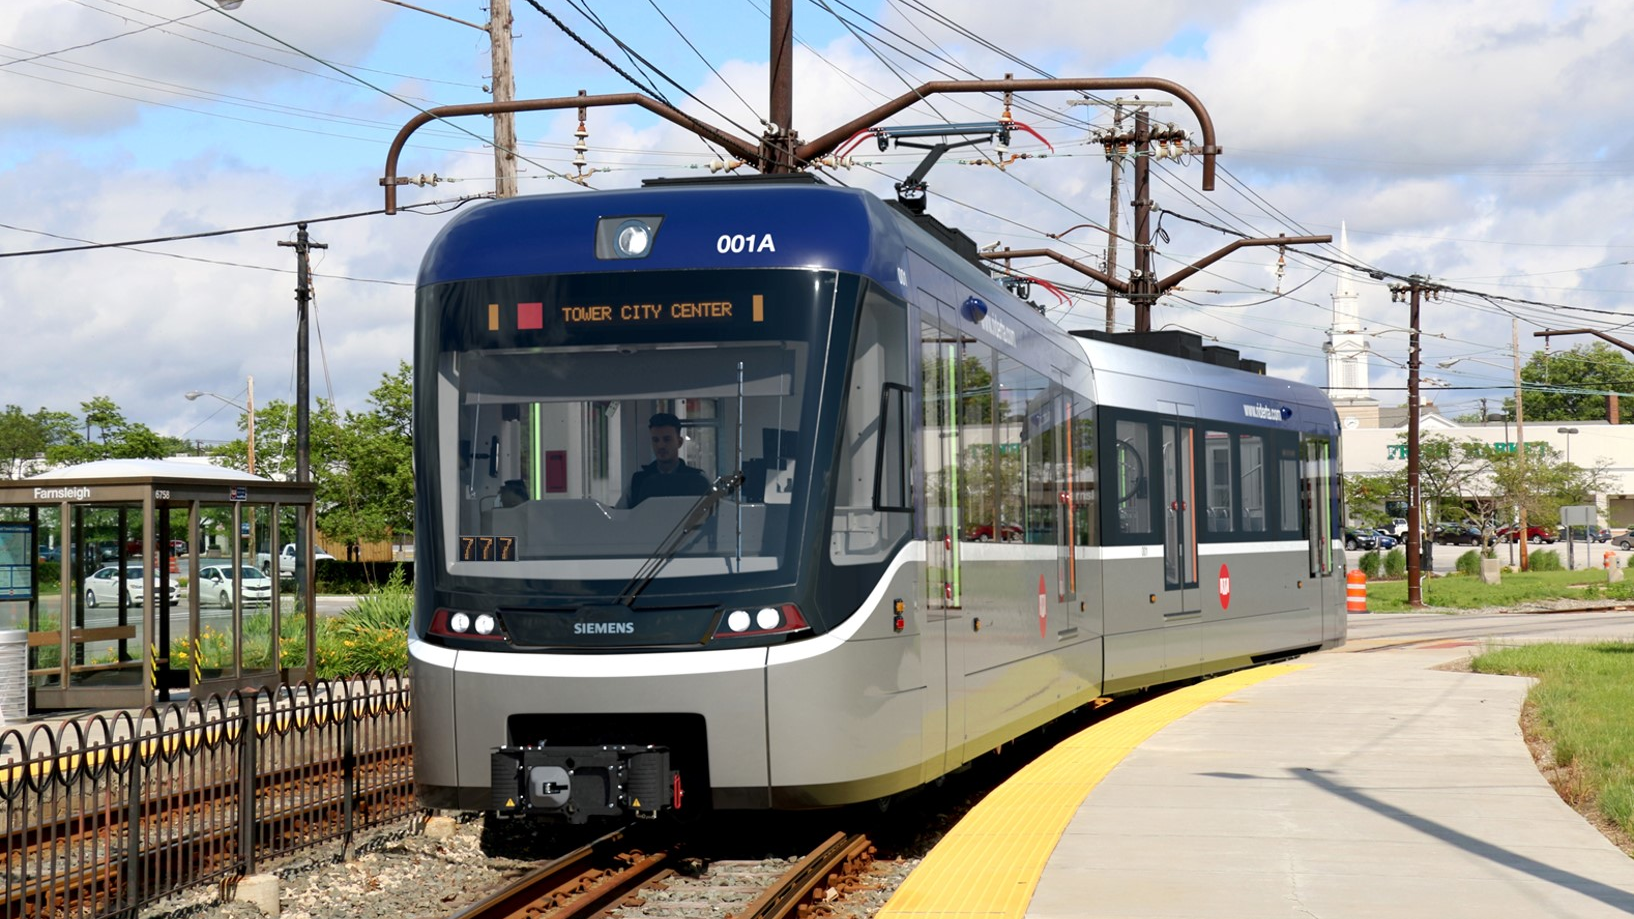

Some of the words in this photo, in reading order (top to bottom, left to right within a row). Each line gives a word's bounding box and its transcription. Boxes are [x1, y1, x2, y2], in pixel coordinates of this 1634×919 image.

[716, 234, 776, 254] 001A
[562, 306, 612, 322] TOWER
[621, 304, 662, 320] CITY
[671, 302, 732, 318] CENTER
[34, 486, 91, 500] Farnsleigh
[155, 489, 170, 499] 6758
[573, 622, 635, 634] SIEMENS
